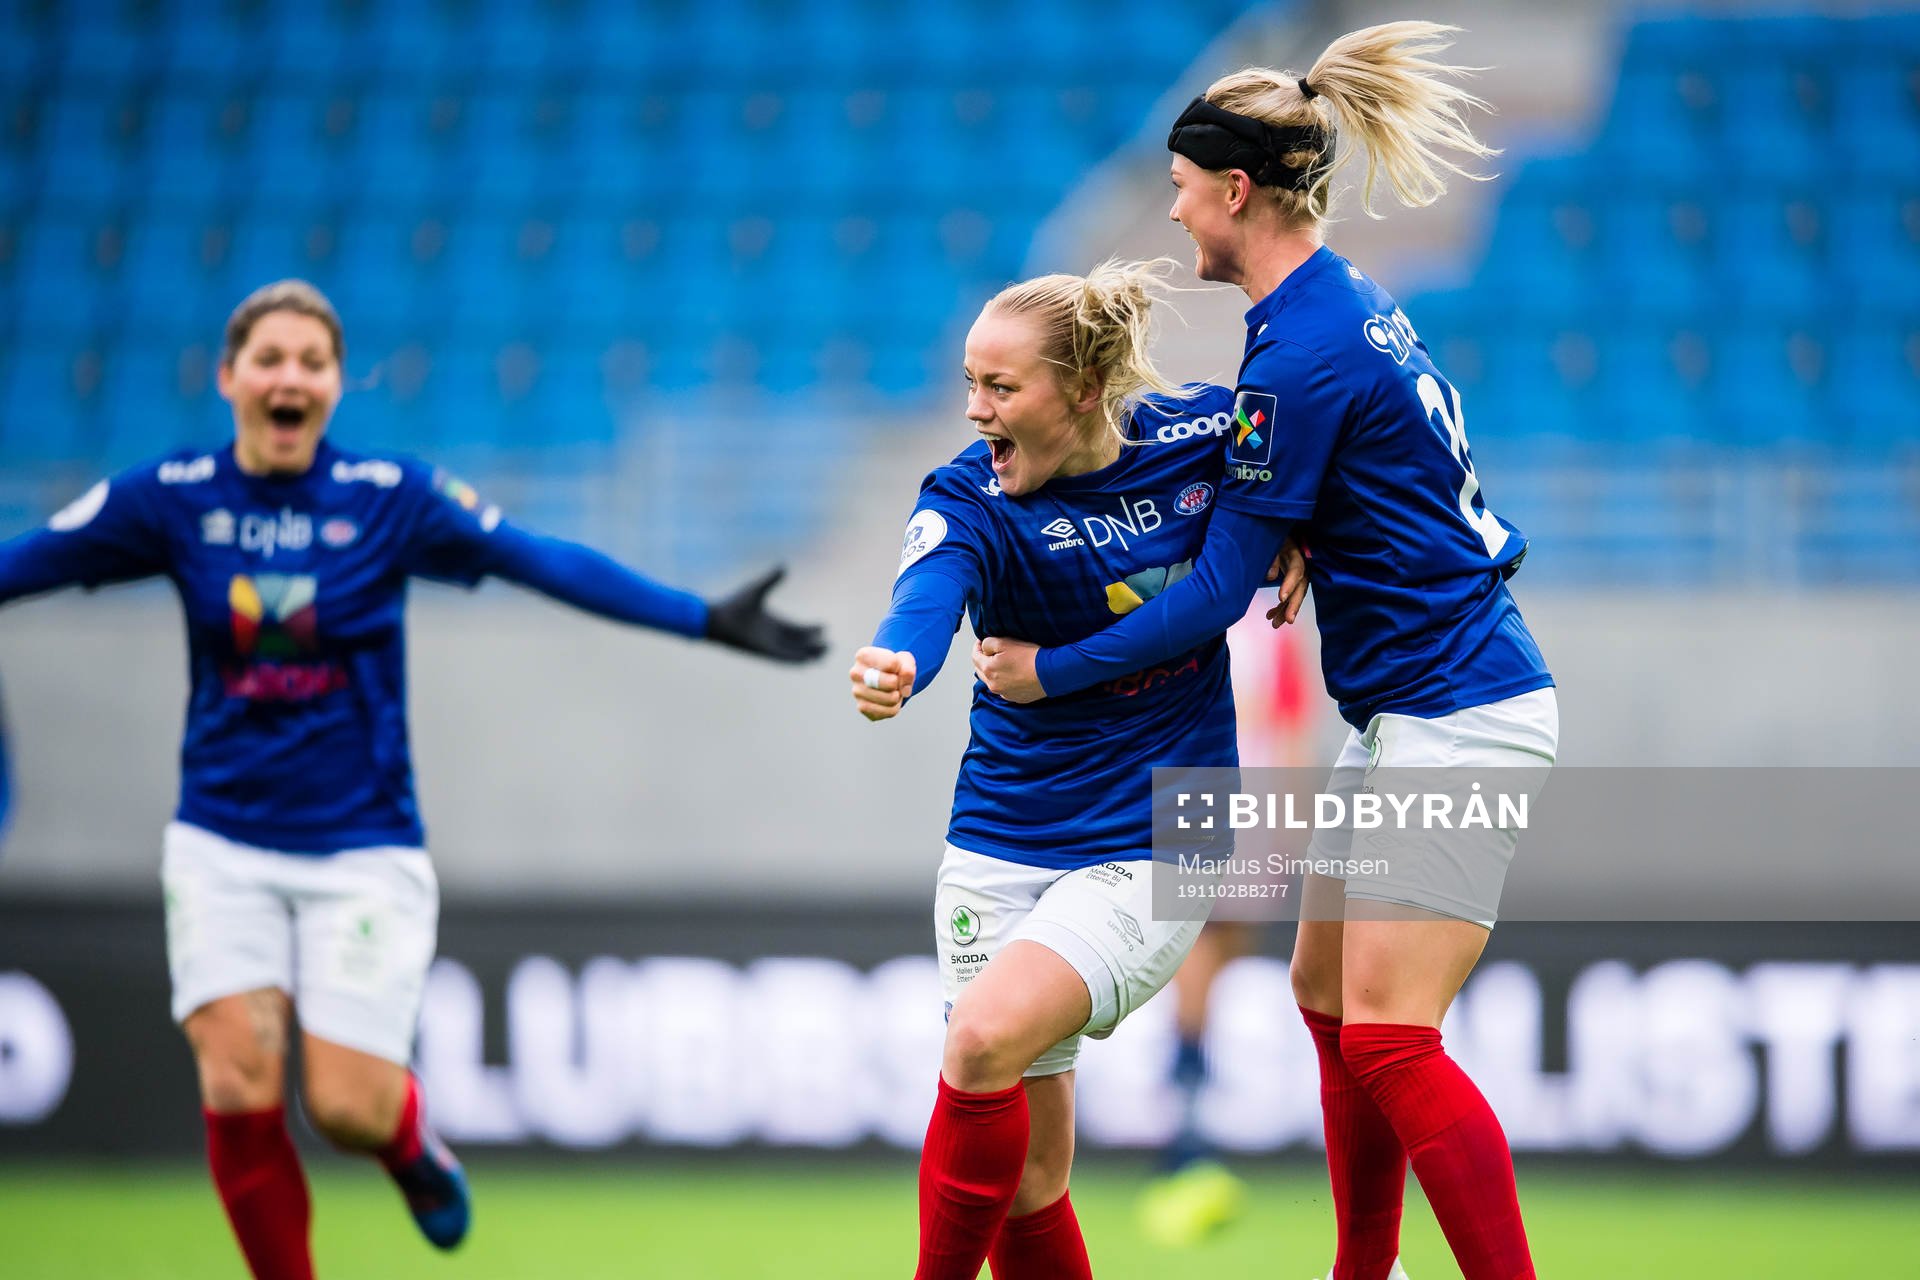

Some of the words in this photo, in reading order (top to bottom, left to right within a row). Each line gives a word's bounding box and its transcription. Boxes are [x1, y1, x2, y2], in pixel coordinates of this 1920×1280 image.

[1157, 412, 1231, 443] coop
[1083, 496, 1162, 551] DNB
[1048, 538, 1085, 551] umbro
[1097, 863, 1134, 881] ODA
[1106, 919, 1135, 952] umbro
[950, 953, 989, 965] ŠKODA
